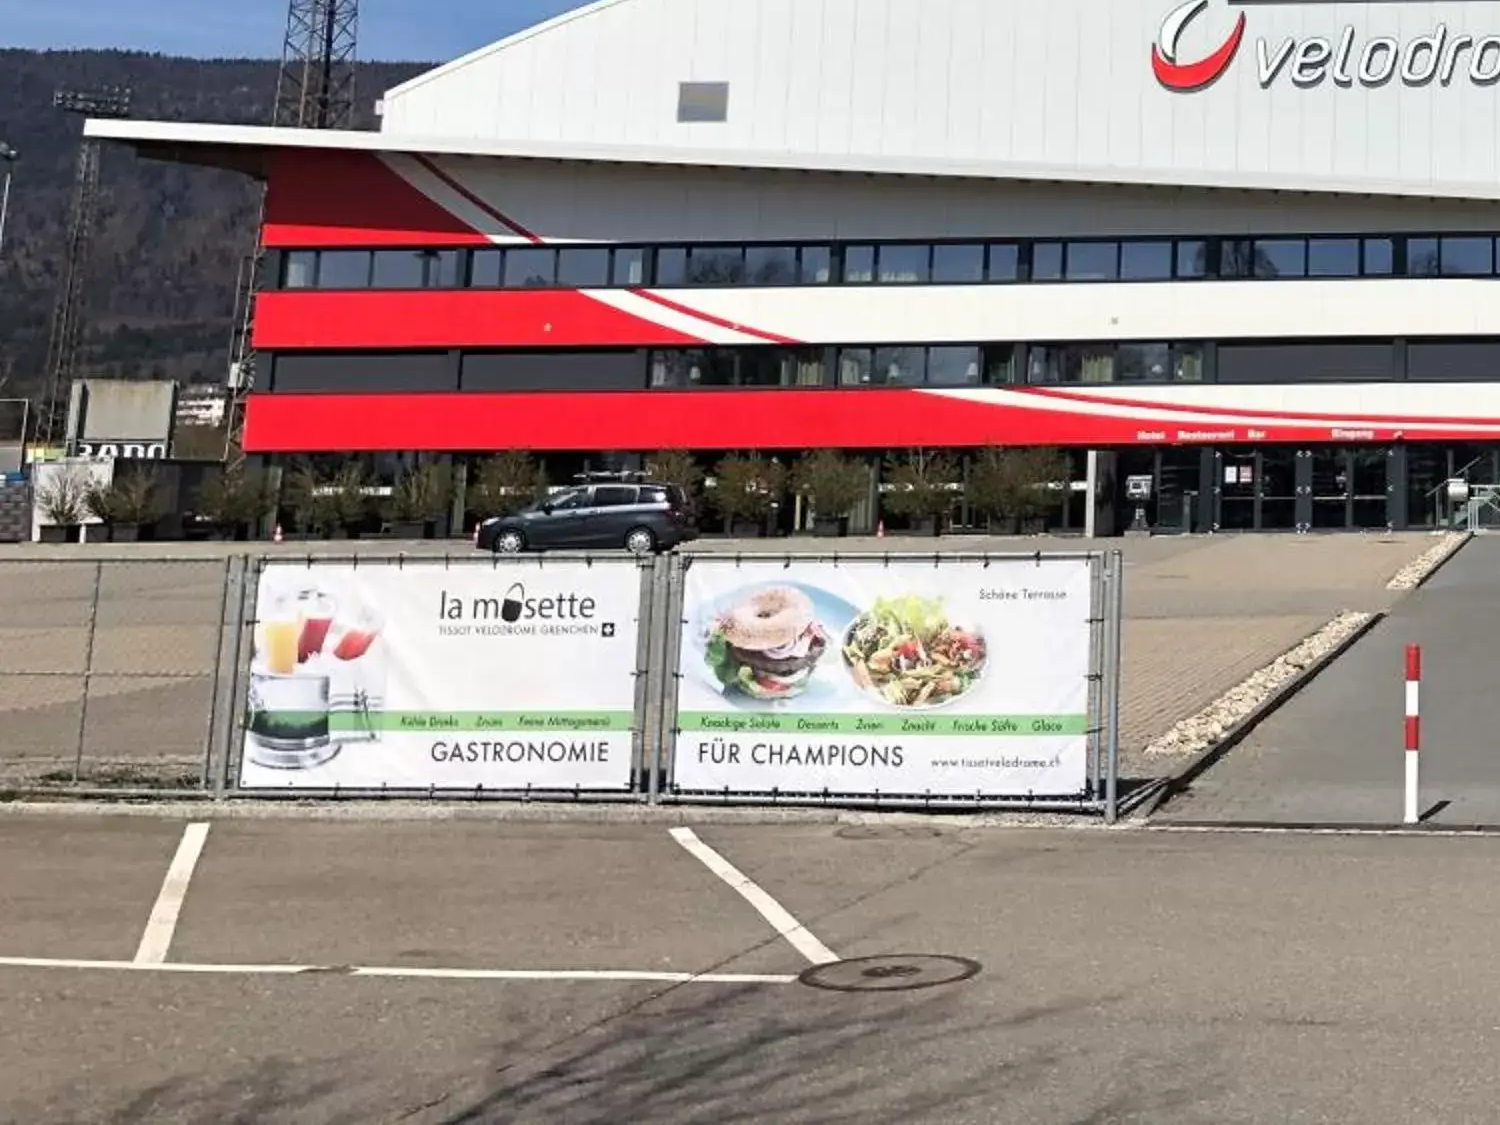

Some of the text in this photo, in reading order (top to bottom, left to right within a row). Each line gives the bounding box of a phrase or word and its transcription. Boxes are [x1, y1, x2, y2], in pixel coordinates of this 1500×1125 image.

[439, 590, 463, 620] la
[439, 624, 599, 636] TISSOT VELODROME GRENCHEN
[431, 741, 609, 762] GASTRONOMIE
[698, 738, 904, 767] FÜR CHAMPIONS
